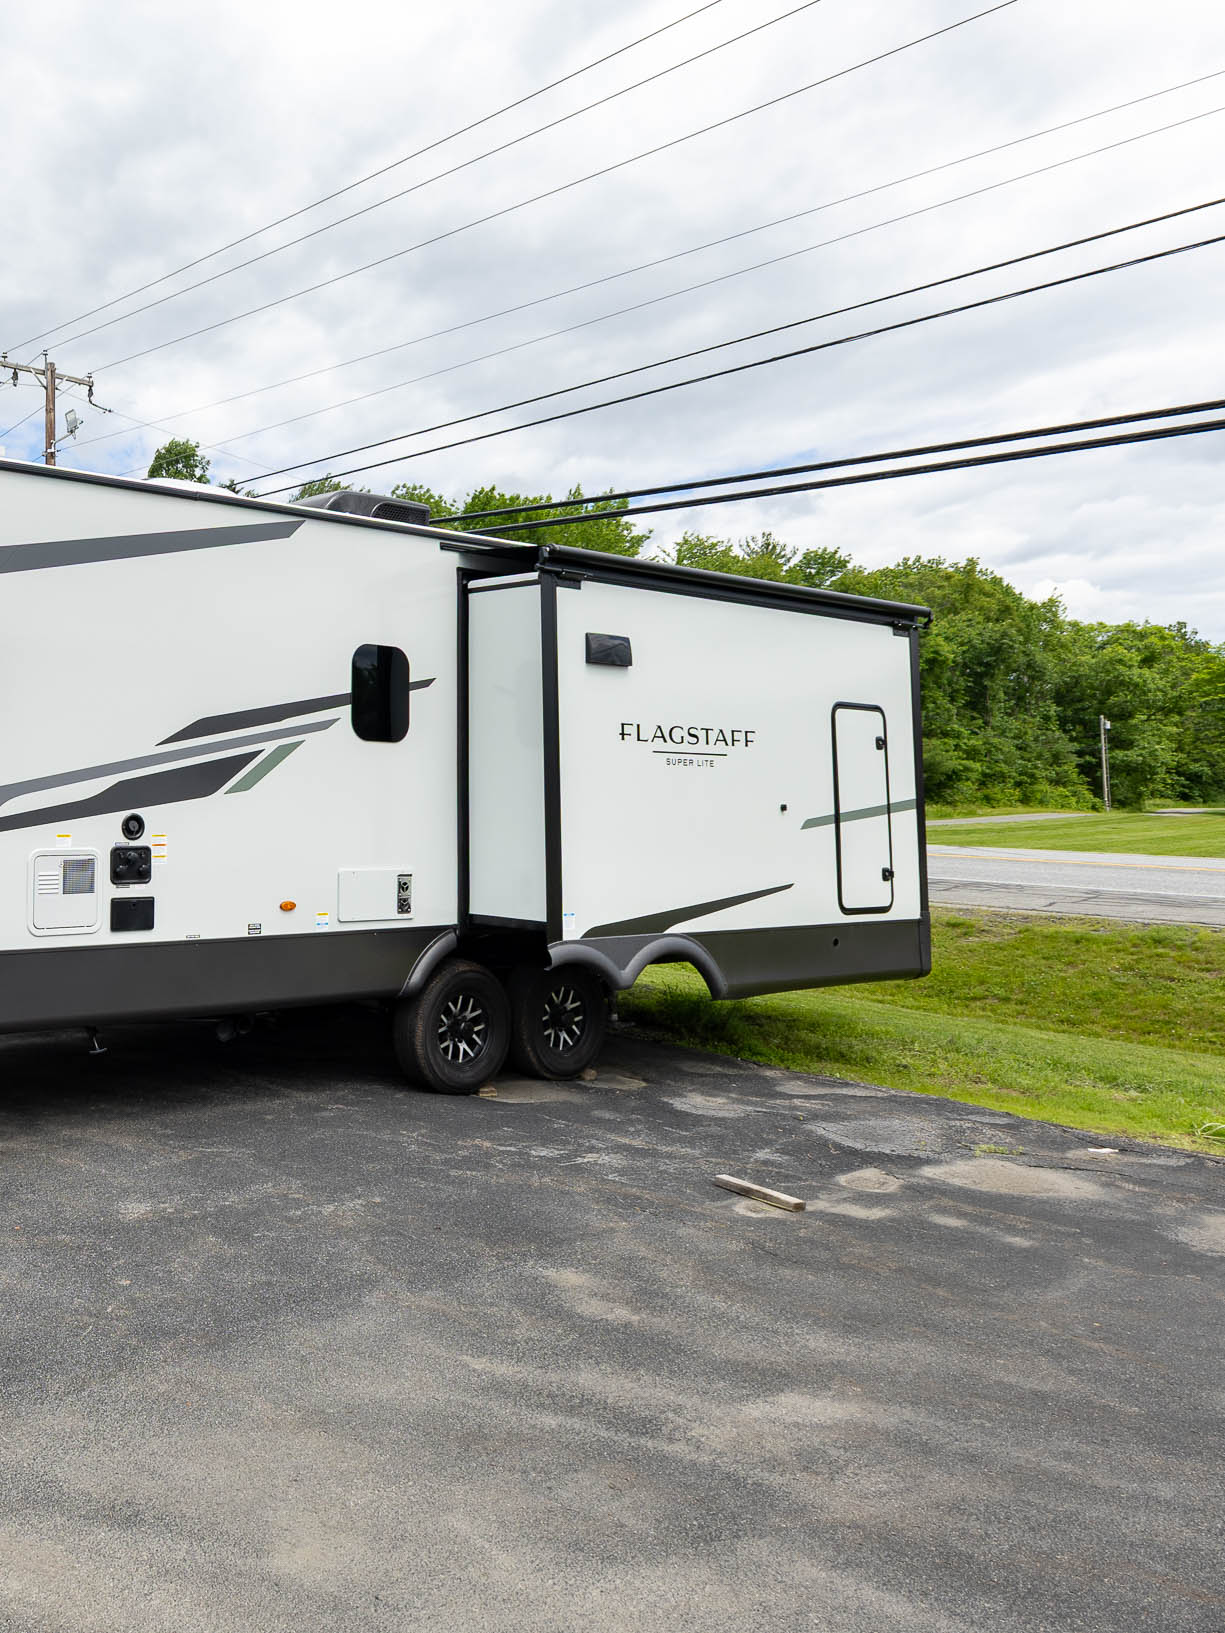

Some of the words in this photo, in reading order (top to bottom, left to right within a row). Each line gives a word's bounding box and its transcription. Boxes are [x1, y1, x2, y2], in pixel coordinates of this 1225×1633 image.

[619, 723, 756, 747] FLAGSTAFF
[666, 758, 694, 767] SUPER
[697, 760, 715, 768] LITE
